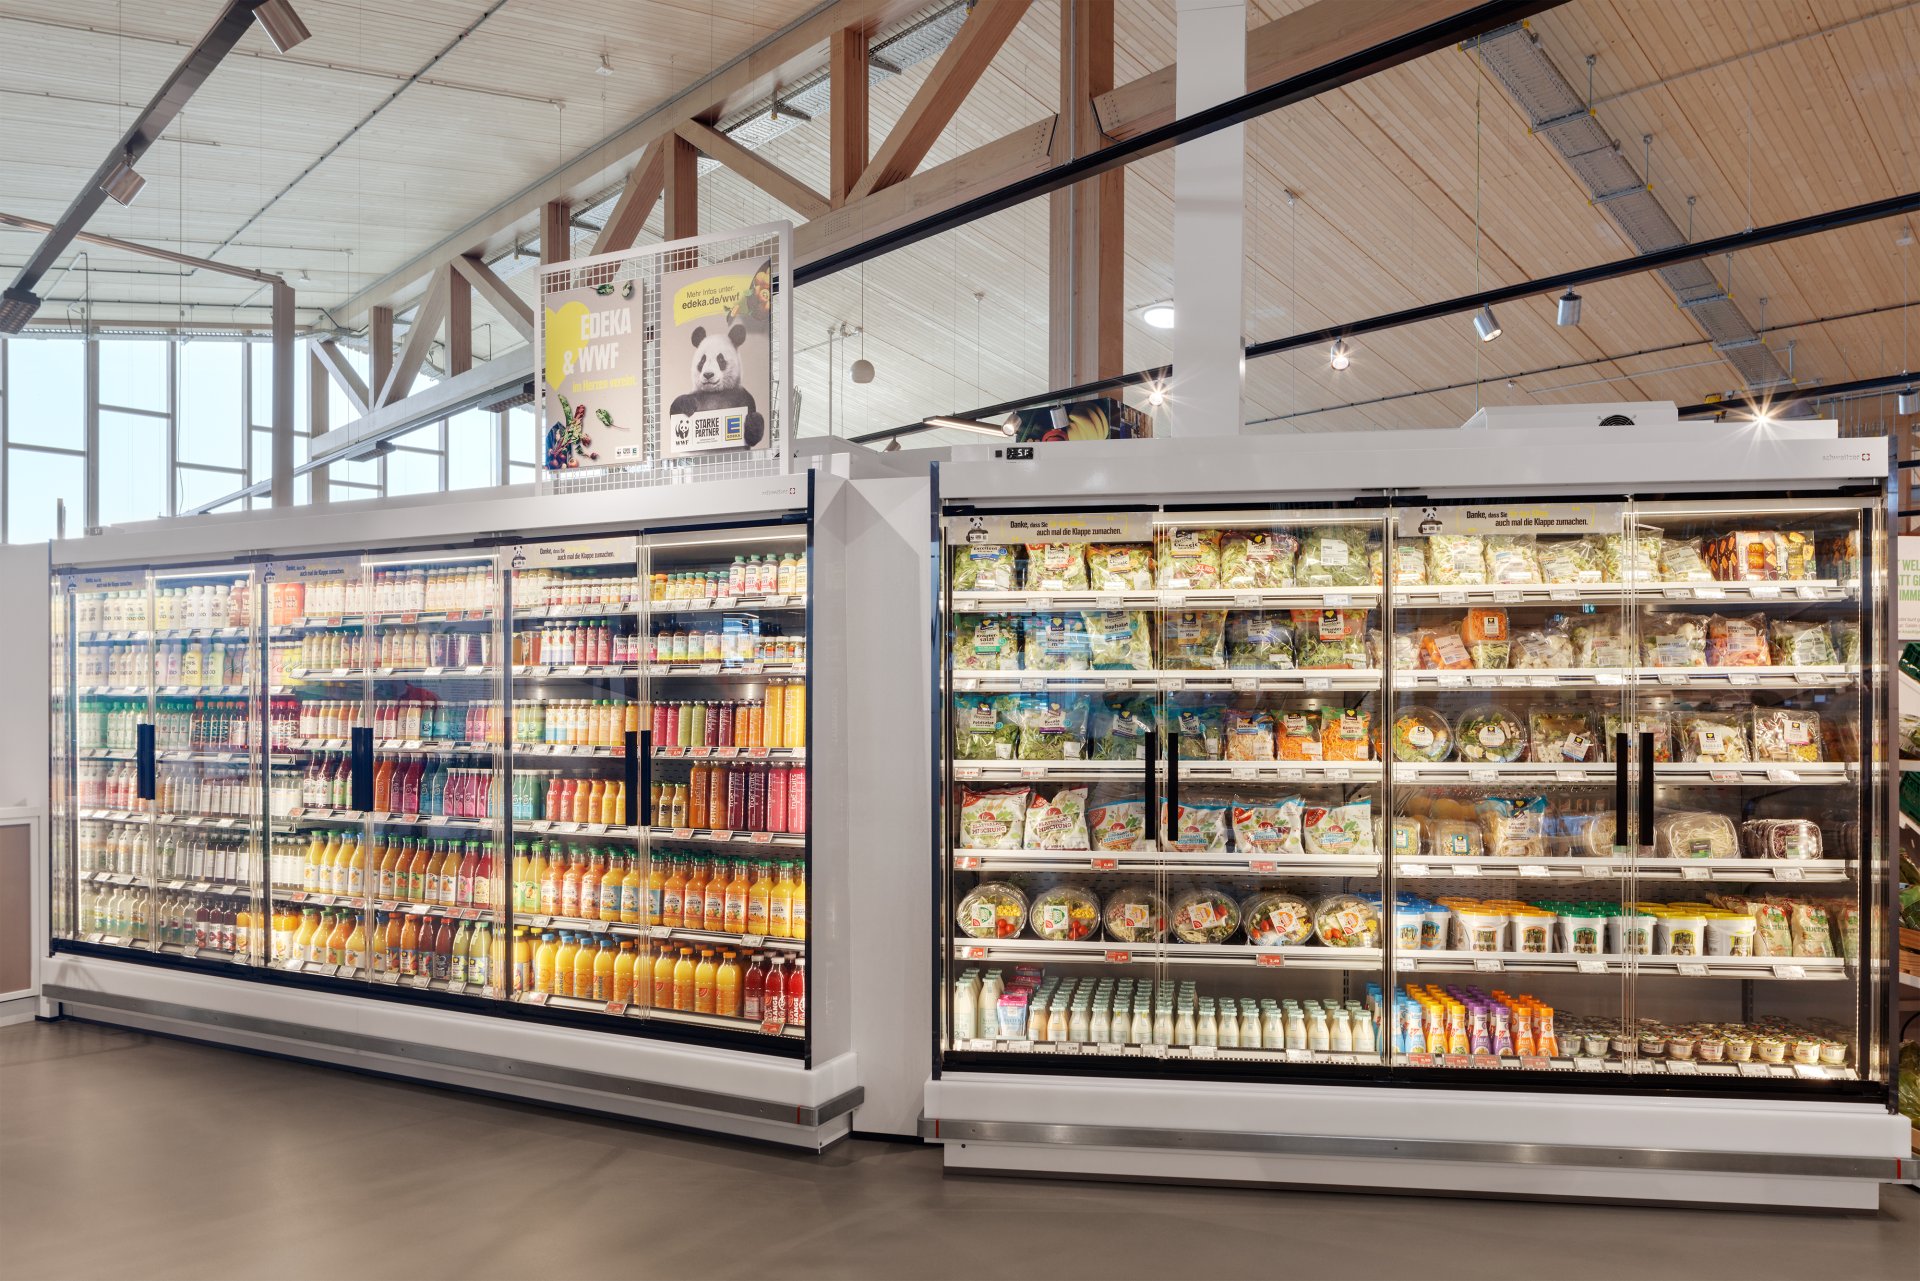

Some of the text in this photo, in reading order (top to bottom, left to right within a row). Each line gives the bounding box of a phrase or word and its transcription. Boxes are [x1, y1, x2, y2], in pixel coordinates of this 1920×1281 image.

[686, 290, 701, 298] Mehr
[682, 292, 740, 310] edeka.de/wwf
[581, 308, 632, 340] EDEKA
[562, 342, 619, 376] & WWF
[695, 417, 719, 429] STARKE
[696, 428, 719, 438] PARTNER
[1467, 511, 1486, 519] Danke,
[1010, 521, 1029, 530] Danke,
[1534, 518, 1554, 527] Klappe
[1072, 528, 1091, 536] Klappe
[1913, 575, 1920, 586] G
